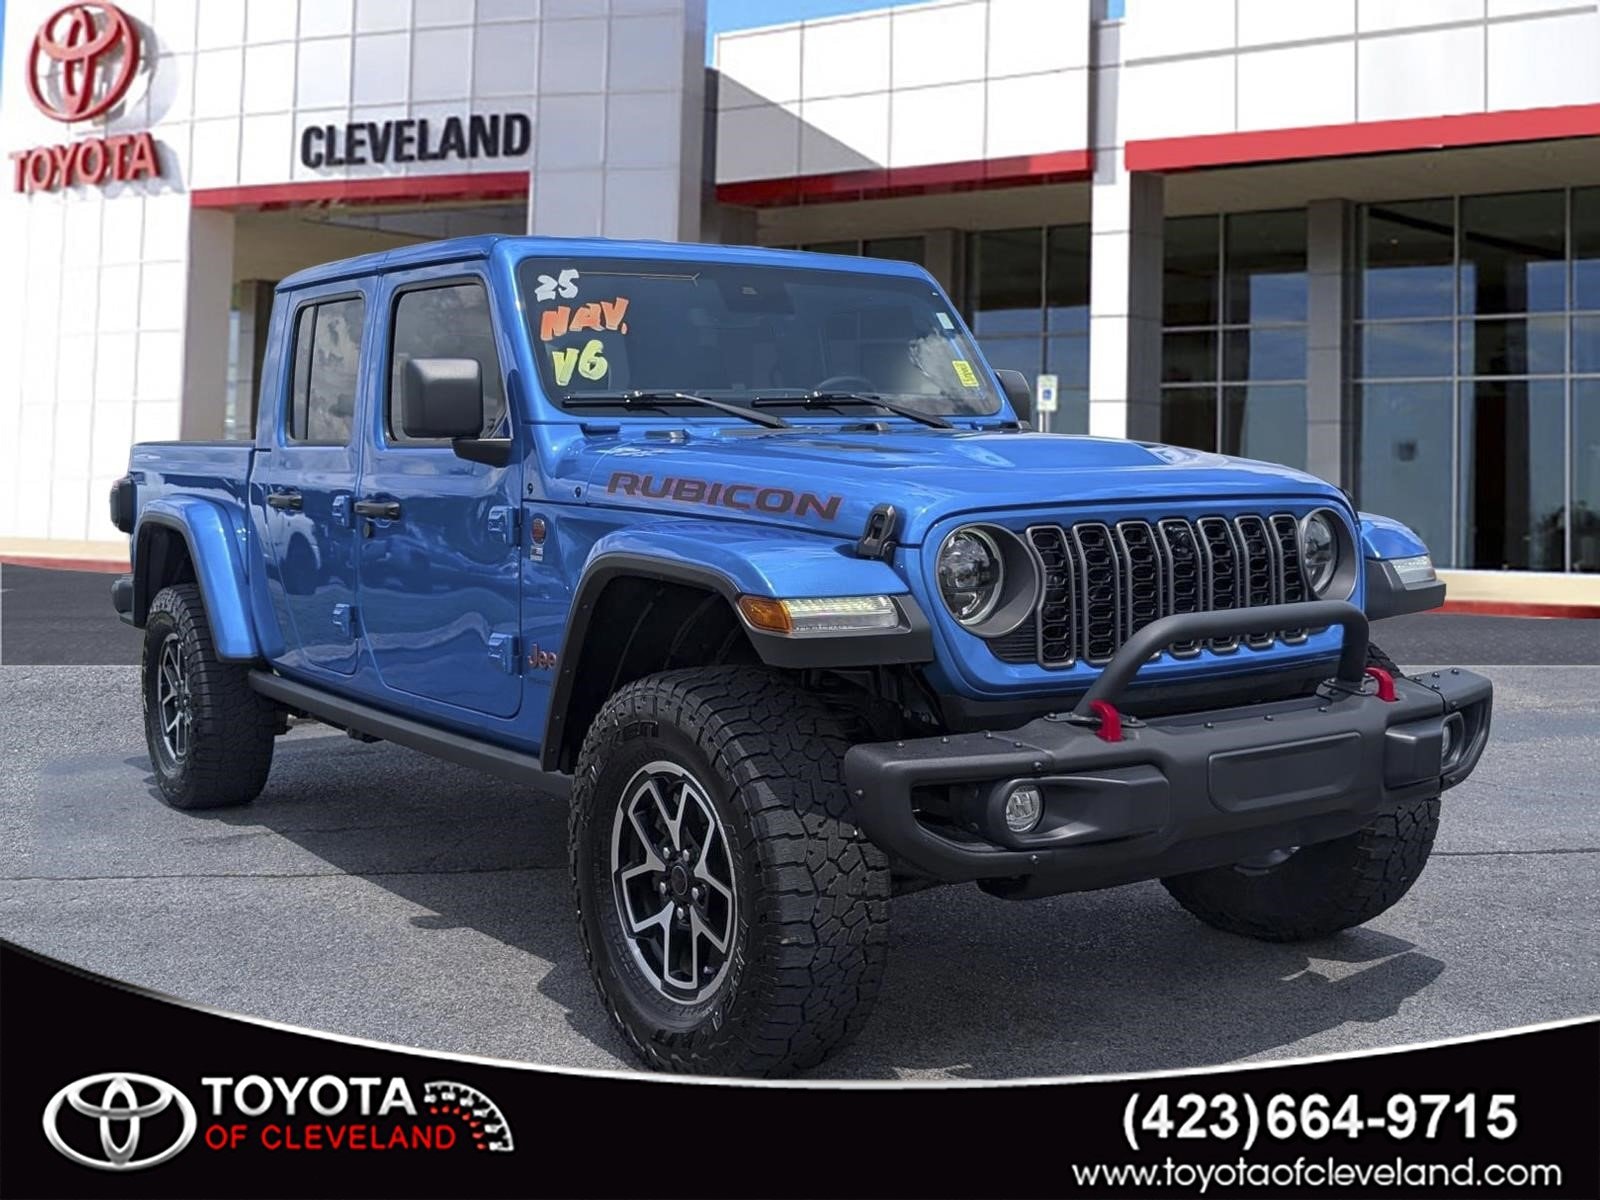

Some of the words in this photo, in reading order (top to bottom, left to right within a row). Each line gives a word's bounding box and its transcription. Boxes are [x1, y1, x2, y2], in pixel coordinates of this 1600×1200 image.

[8, 131, 161, 193] TOYOTA
[301, 112, 532, 169] CLEVELAND
[534, 268, 580, 303] 25
[606, 471, 843, 521] RUBICON
